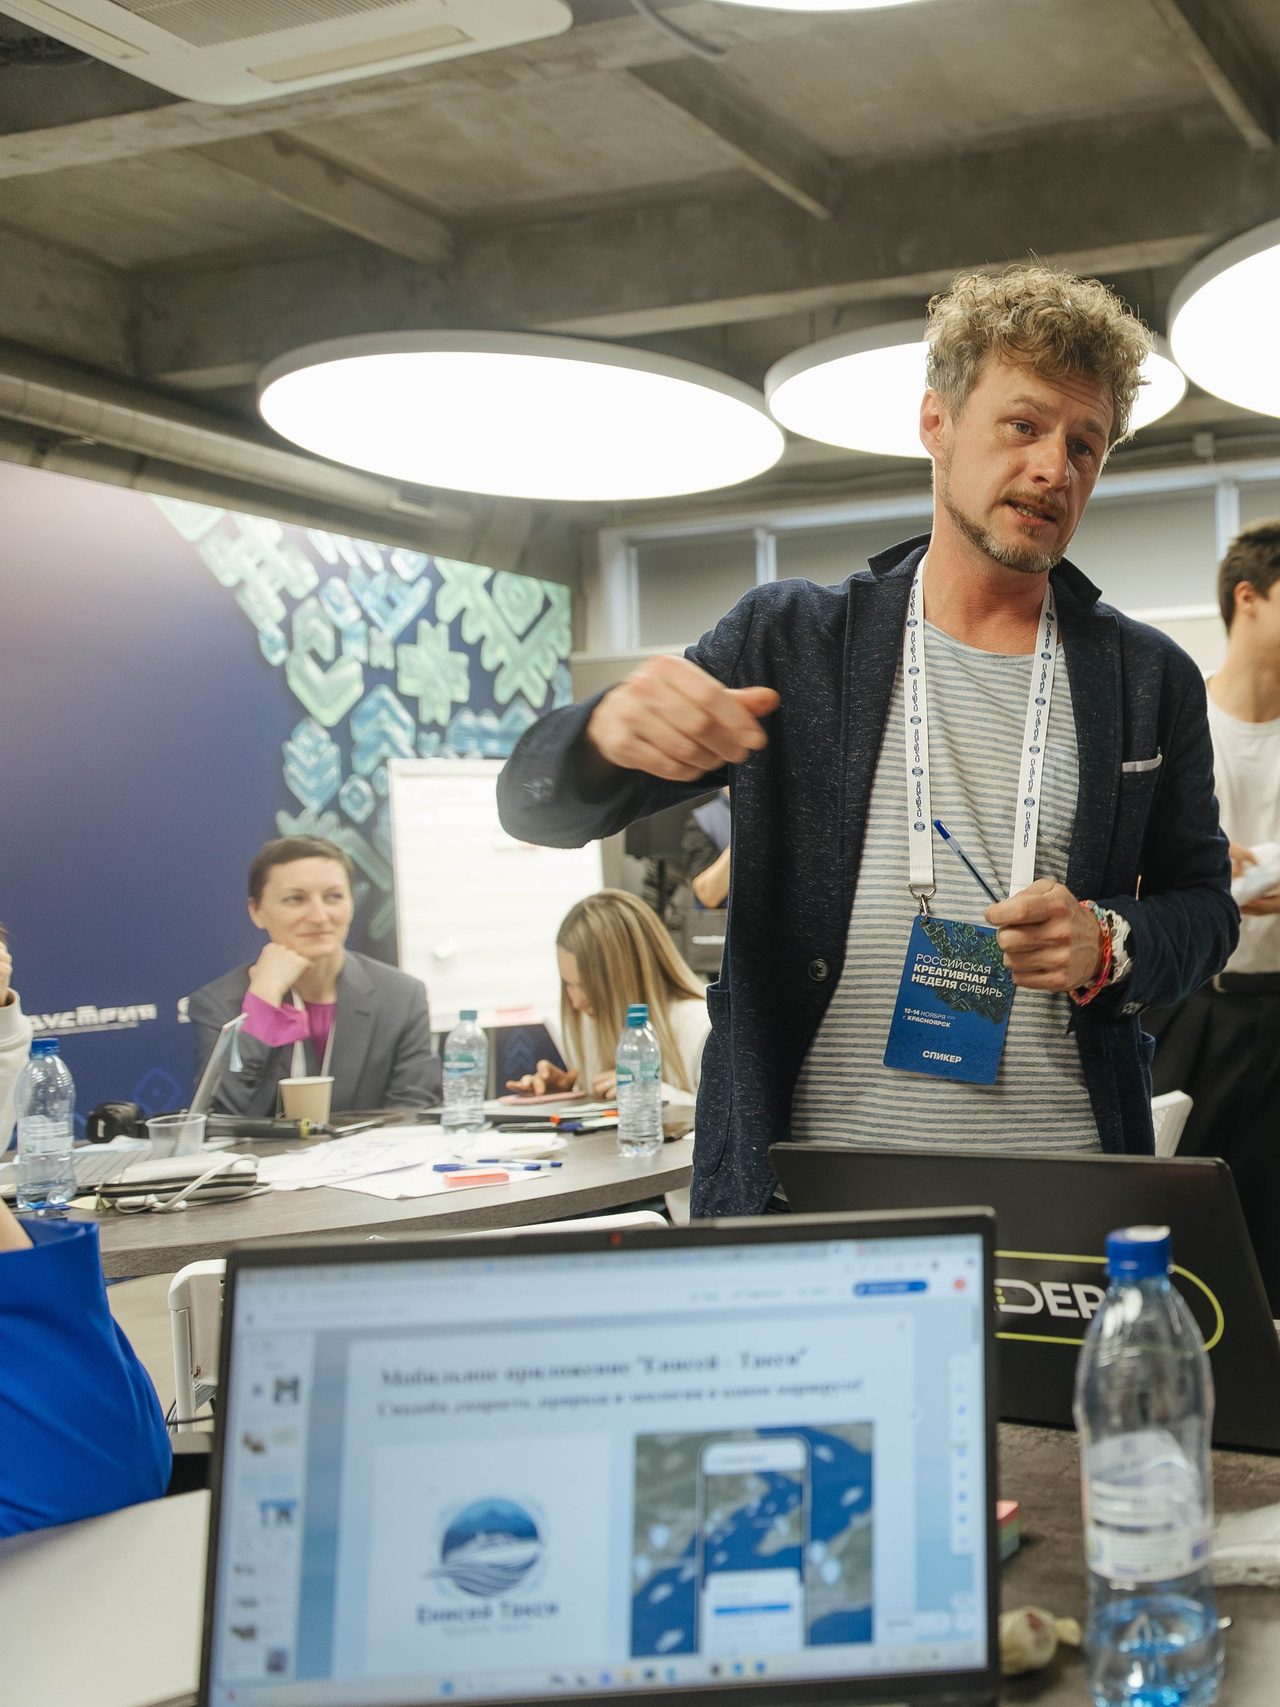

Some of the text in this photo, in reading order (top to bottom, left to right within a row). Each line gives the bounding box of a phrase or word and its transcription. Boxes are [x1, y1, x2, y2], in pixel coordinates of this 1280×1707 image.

[913, 963, 988, 985] КРЕАТИВНАЯ
[915, 953, 992, 975] РОССИЙСКАЯ
[911, 973, 1003, 998] НЕДЕЛЯ СИБИРЬ
[907, 1015, 951, 1028] КРАСНОЯРСК
[922, 1050, 962, 1063] СПИКЕР
